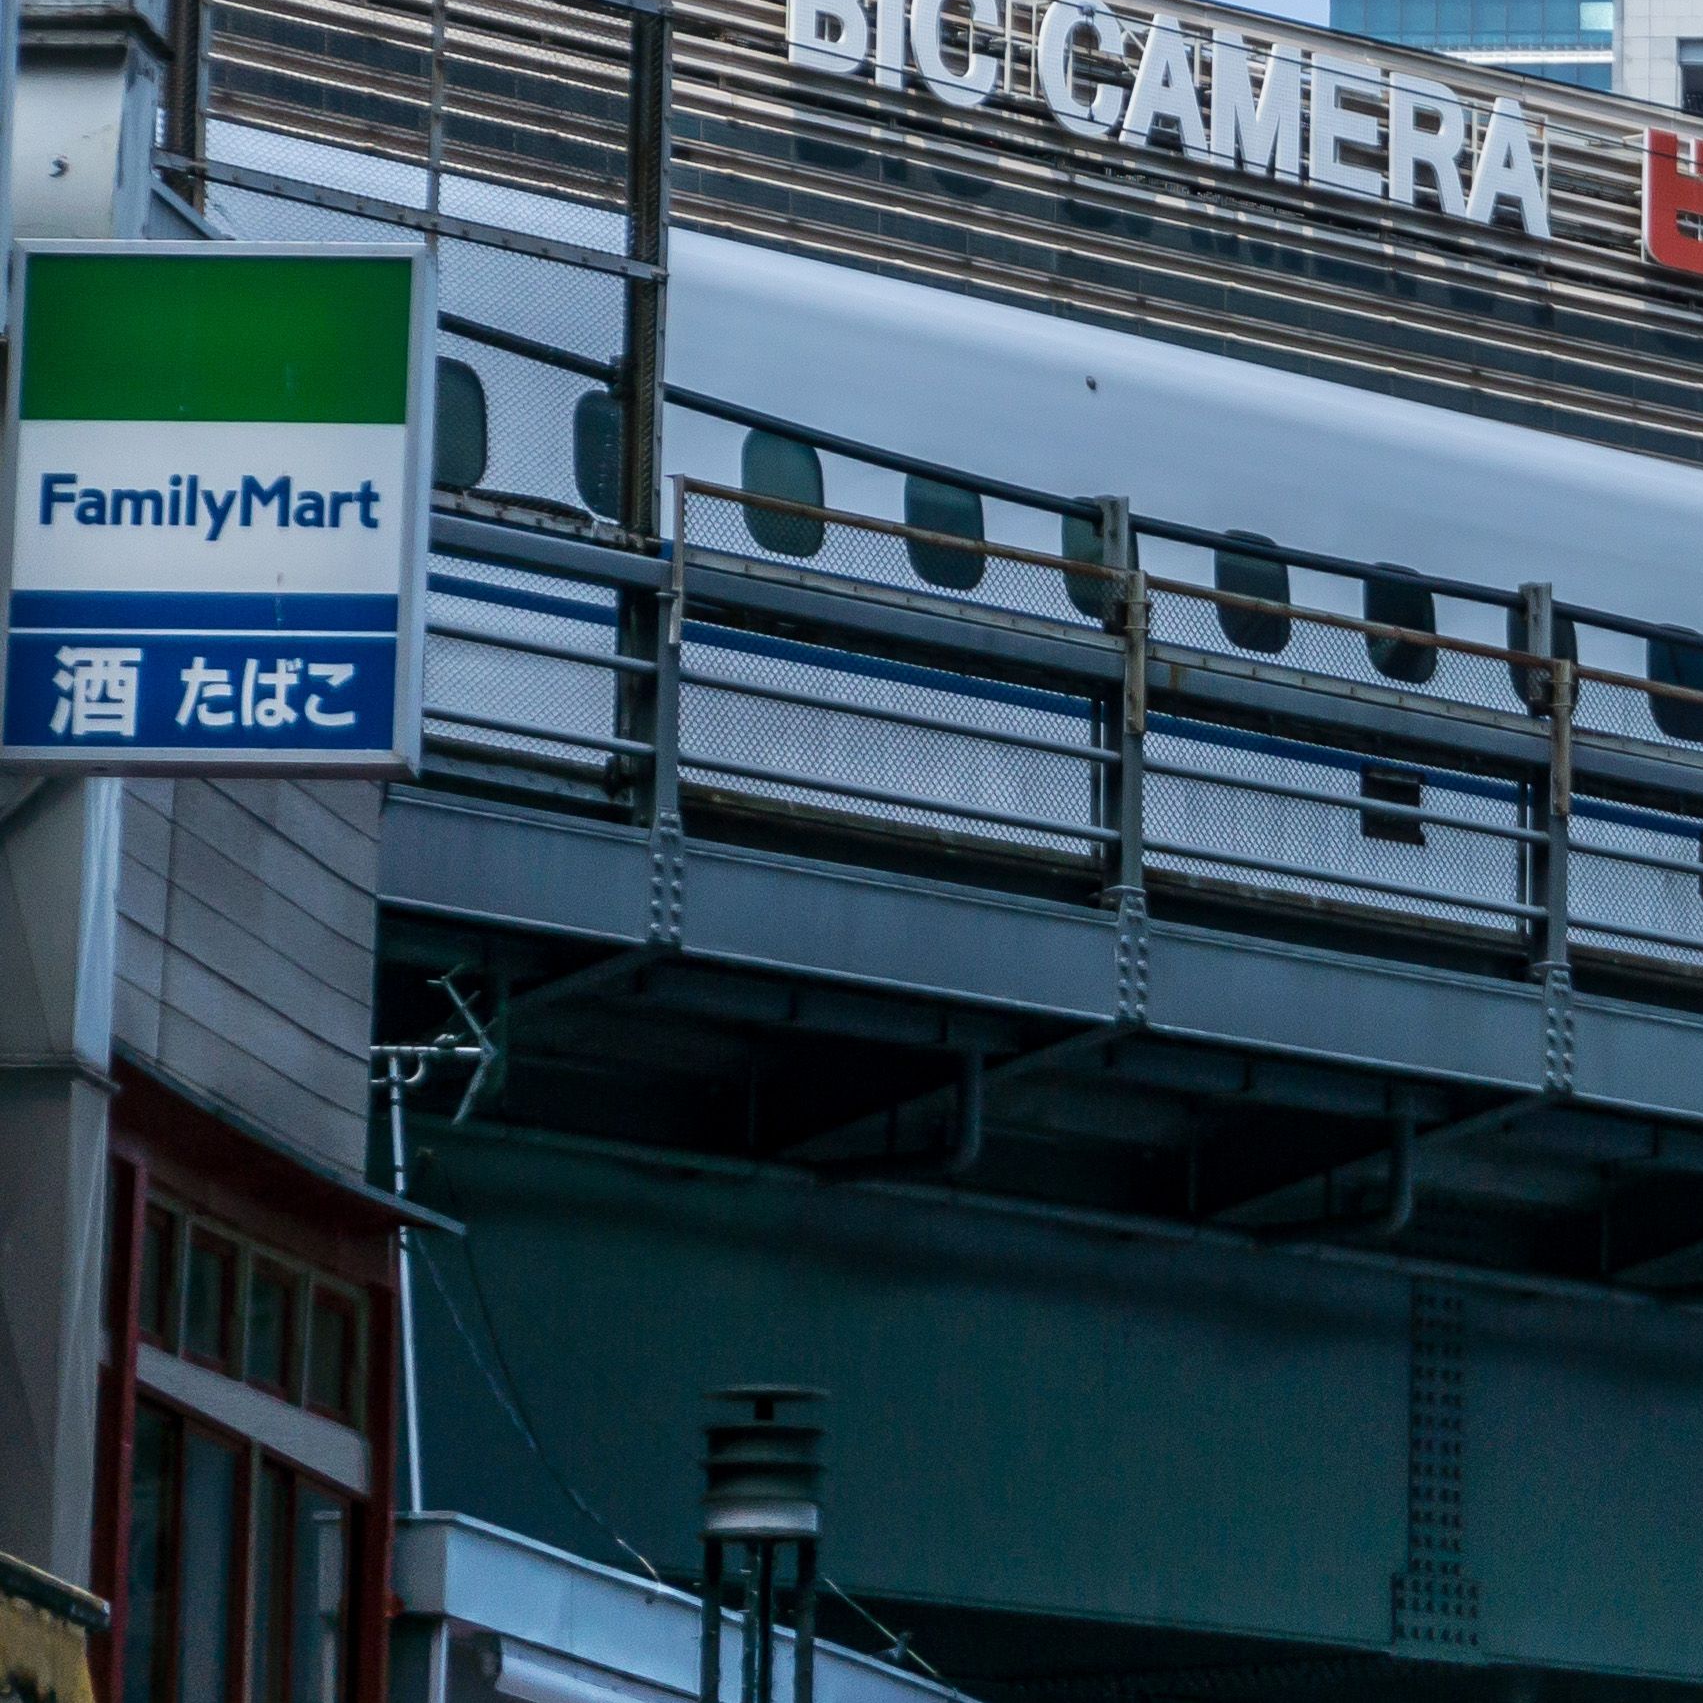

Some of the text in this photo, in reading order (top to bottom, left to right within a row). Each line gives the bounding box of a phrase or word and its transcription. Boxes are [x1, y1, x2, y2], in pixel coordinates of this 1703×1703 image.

[39, 472, 380, 541] FamilyMart
[50, 646, 357, 738] 酒 たばこ
